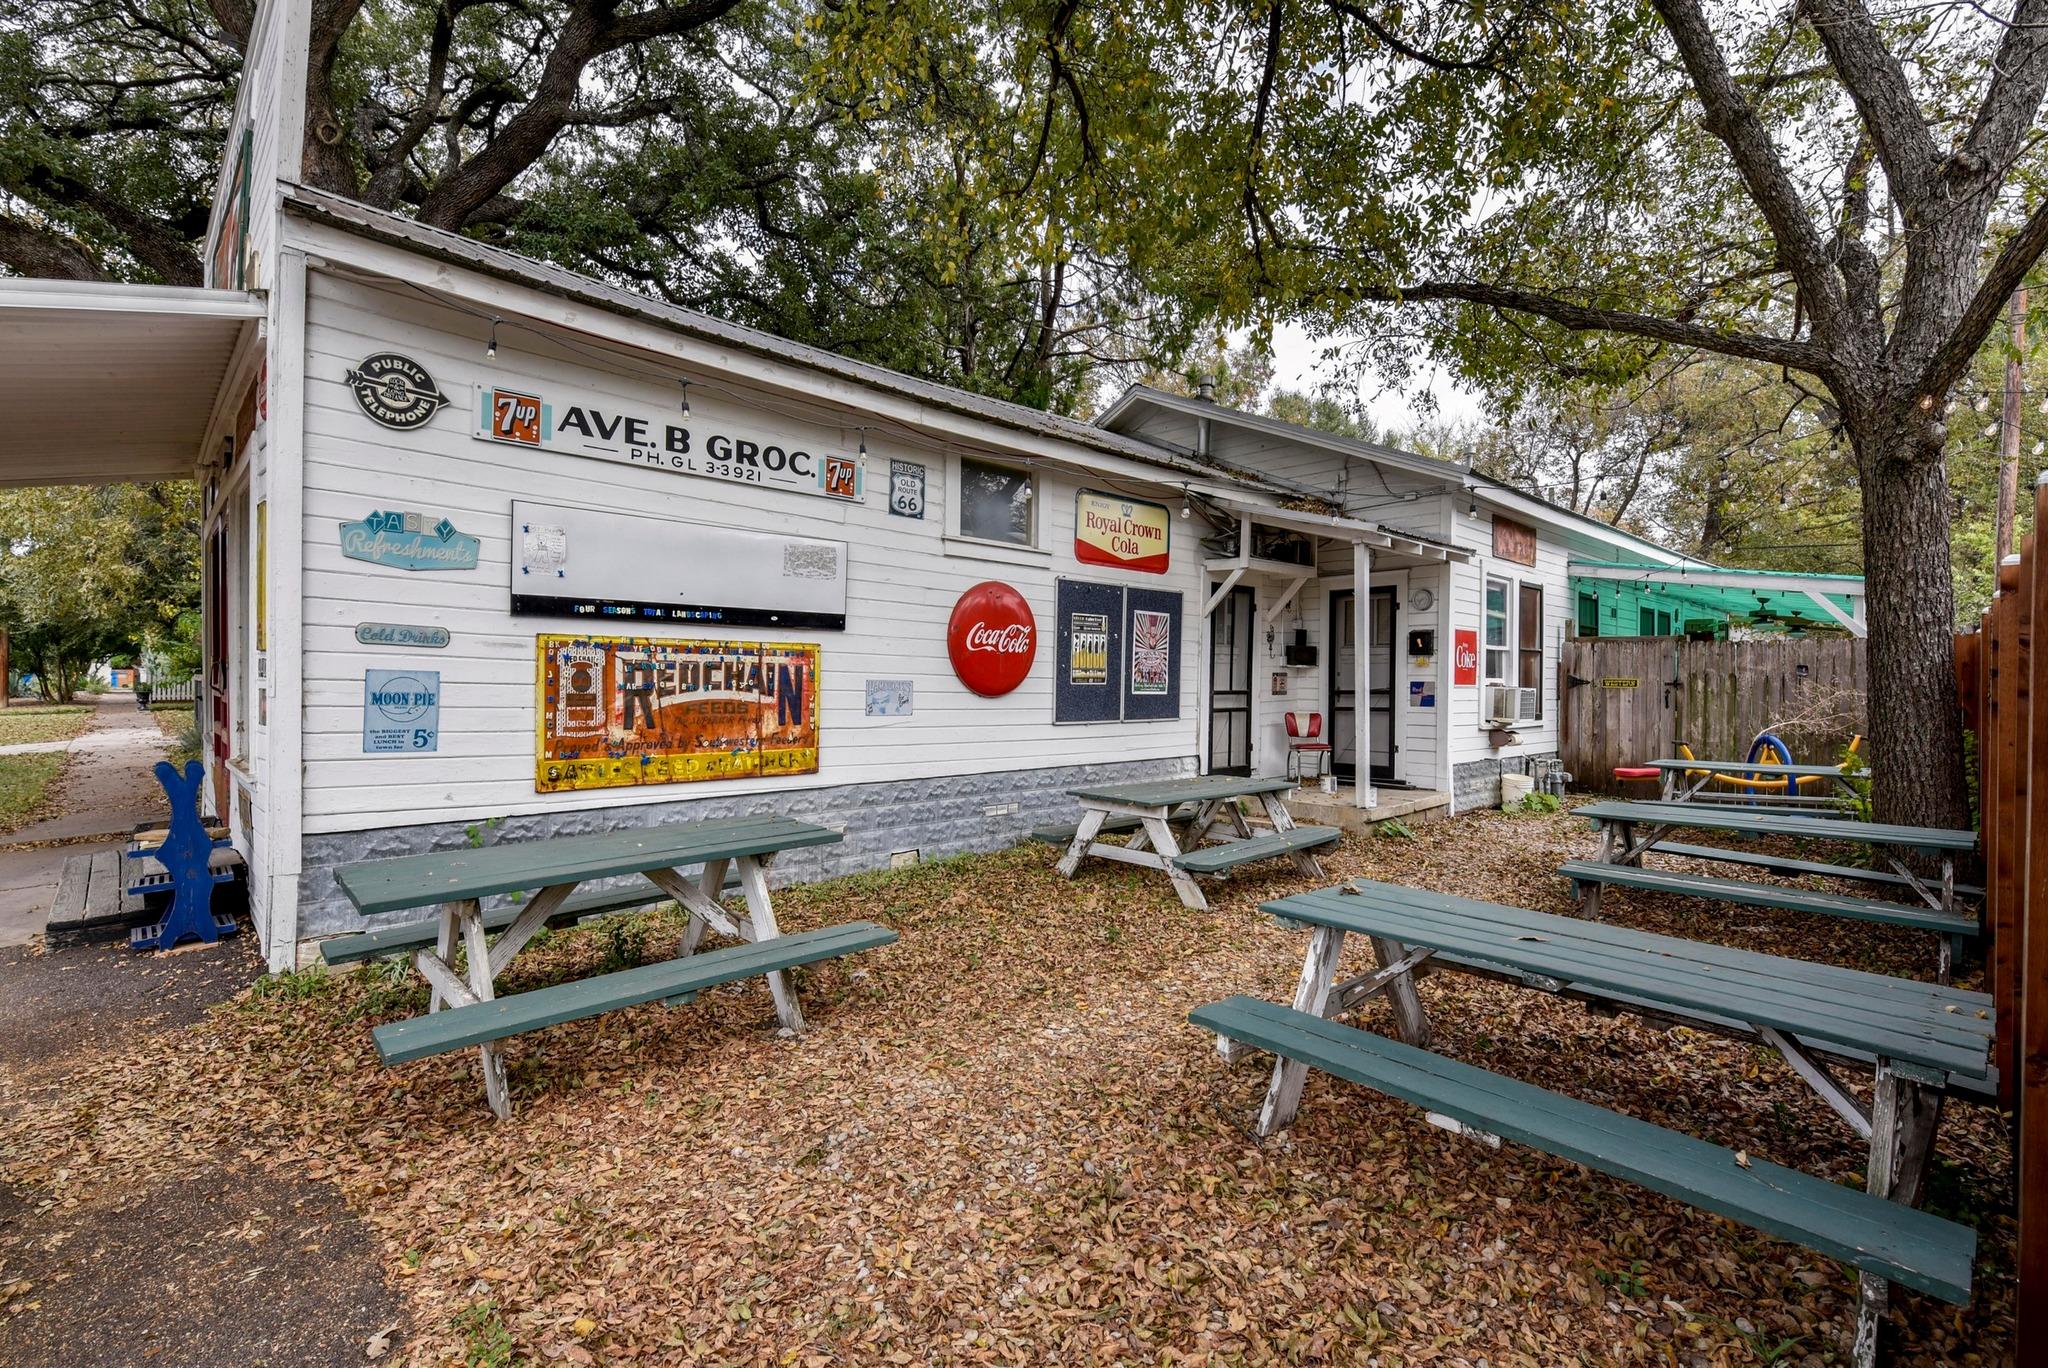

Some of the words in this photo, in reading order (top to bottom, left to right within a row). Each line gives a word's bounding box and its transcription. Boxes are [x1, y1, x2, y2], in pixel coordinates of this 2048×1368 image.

[371, 359, 425, 382] PUBLIC
[361, 389, 430, 422] TELEPHONE
[557, 406, 656, 448] AVE.
[665, 425, 690, 454] B
[706, 435, 816, 478] GROC.
[631, 449, 664, 466] PH.
[671, 456, 696, 471] GL
[706, 462, 761, 482] 3-3921
[892, 461, 924, 475] HISTORIC
[898, 487, 917, 495] ROUTE
[900, 479, 916, 488] OLD
[898, 495, 917, 511] 66
[370, 514, 450, 539] TASTY
[1086, 512, 1121, 535] Royal
[1124, 520, 1162, 540] Crown
[345, 529, 473, 561] Refreshments
[1112, 536, 1139, 555] Cola
[574, 605, 595, 613] FOUR
[603, 606, 636, 615] SEASONS
[643, 608, 665, 617] TOTAL
[672, 610, 723, 619] LANDSCAPING
[360, 627, 394, 641] Cold
[400, 629, 446, 645] Drinks
[966, 621, 1032, 654] Coca-Cola
[1457, 645, 1475, 668] Coke
[370, 692, 409, 706] MOON
[414, 692, 436, 706] PIE
[684, 702, 748, 714] FEEDS
[555, 739, 599, 753] Proved
